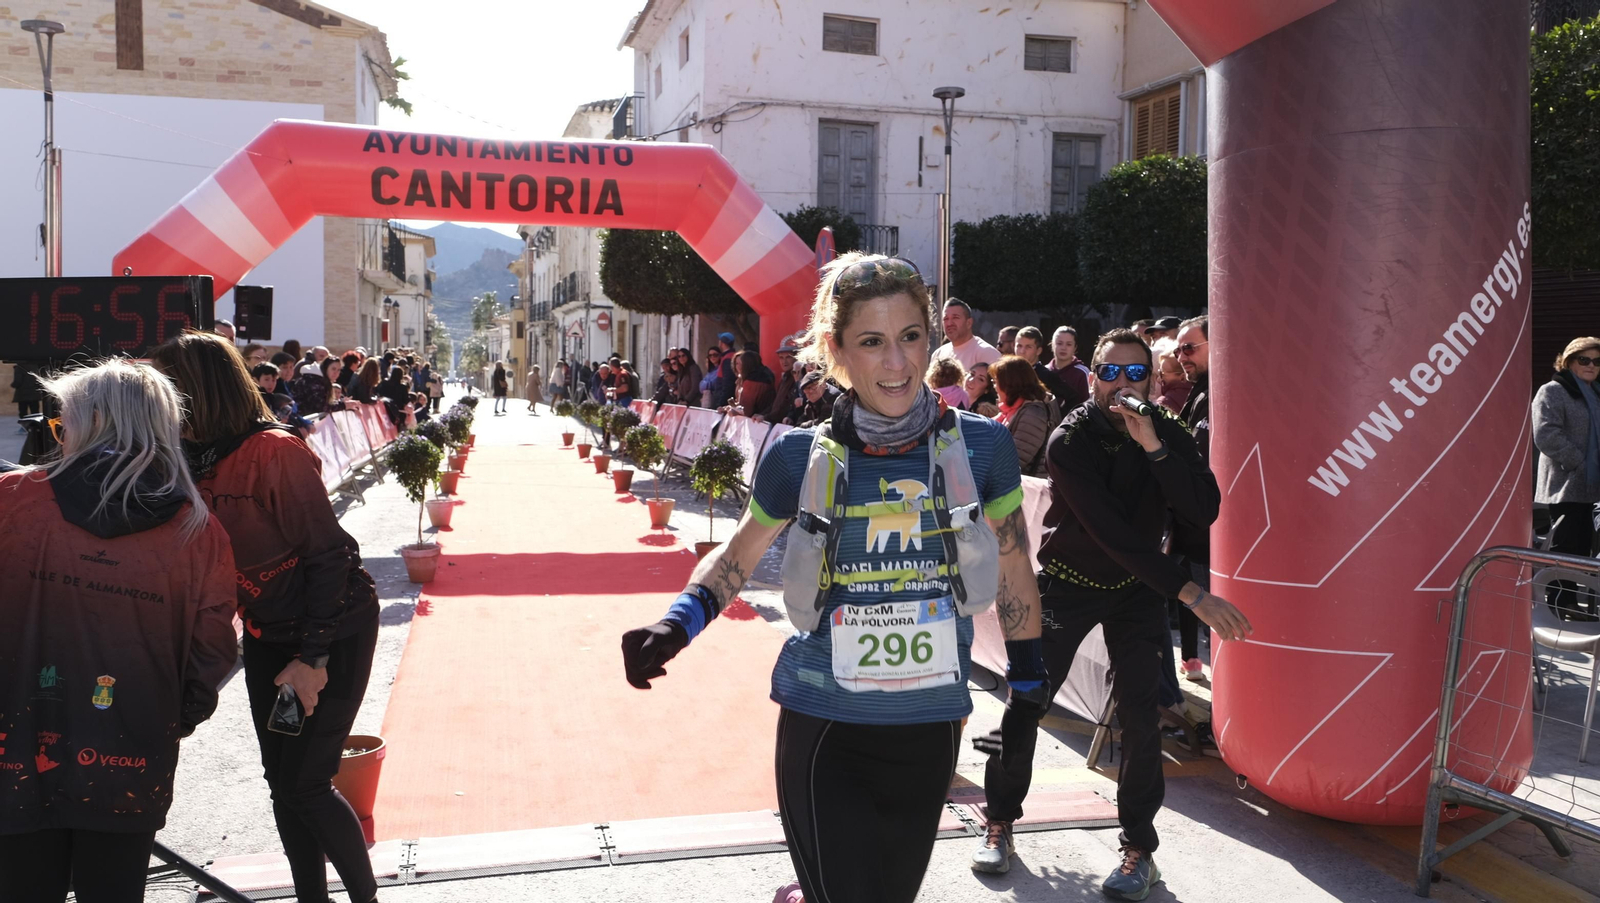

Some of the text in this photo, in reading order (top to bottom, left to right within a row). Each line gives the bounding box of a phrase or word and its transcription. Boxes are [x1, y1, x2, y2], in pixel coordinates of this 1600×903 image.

[363, 131, 633, 167] AYUNTAMIENTO
[371, 166, 624, 215] CANTORIA
[29, 285, 192, 350] 16:56
[1307, 202, 1531, 497] www.teamergy.es
[63, 575, 81, 587] DE
[86, 581, 165, 604] ALMANZORA
[845, 617, 858, 627] LA
[862, 616, 915, 627] PÓLVORA
[848, 606, 859, 616] IV
[864, 605, 893, 616] CxM
[858, 631, 933, 667] 296
[100, 754, 146, 768] VEOLIA
